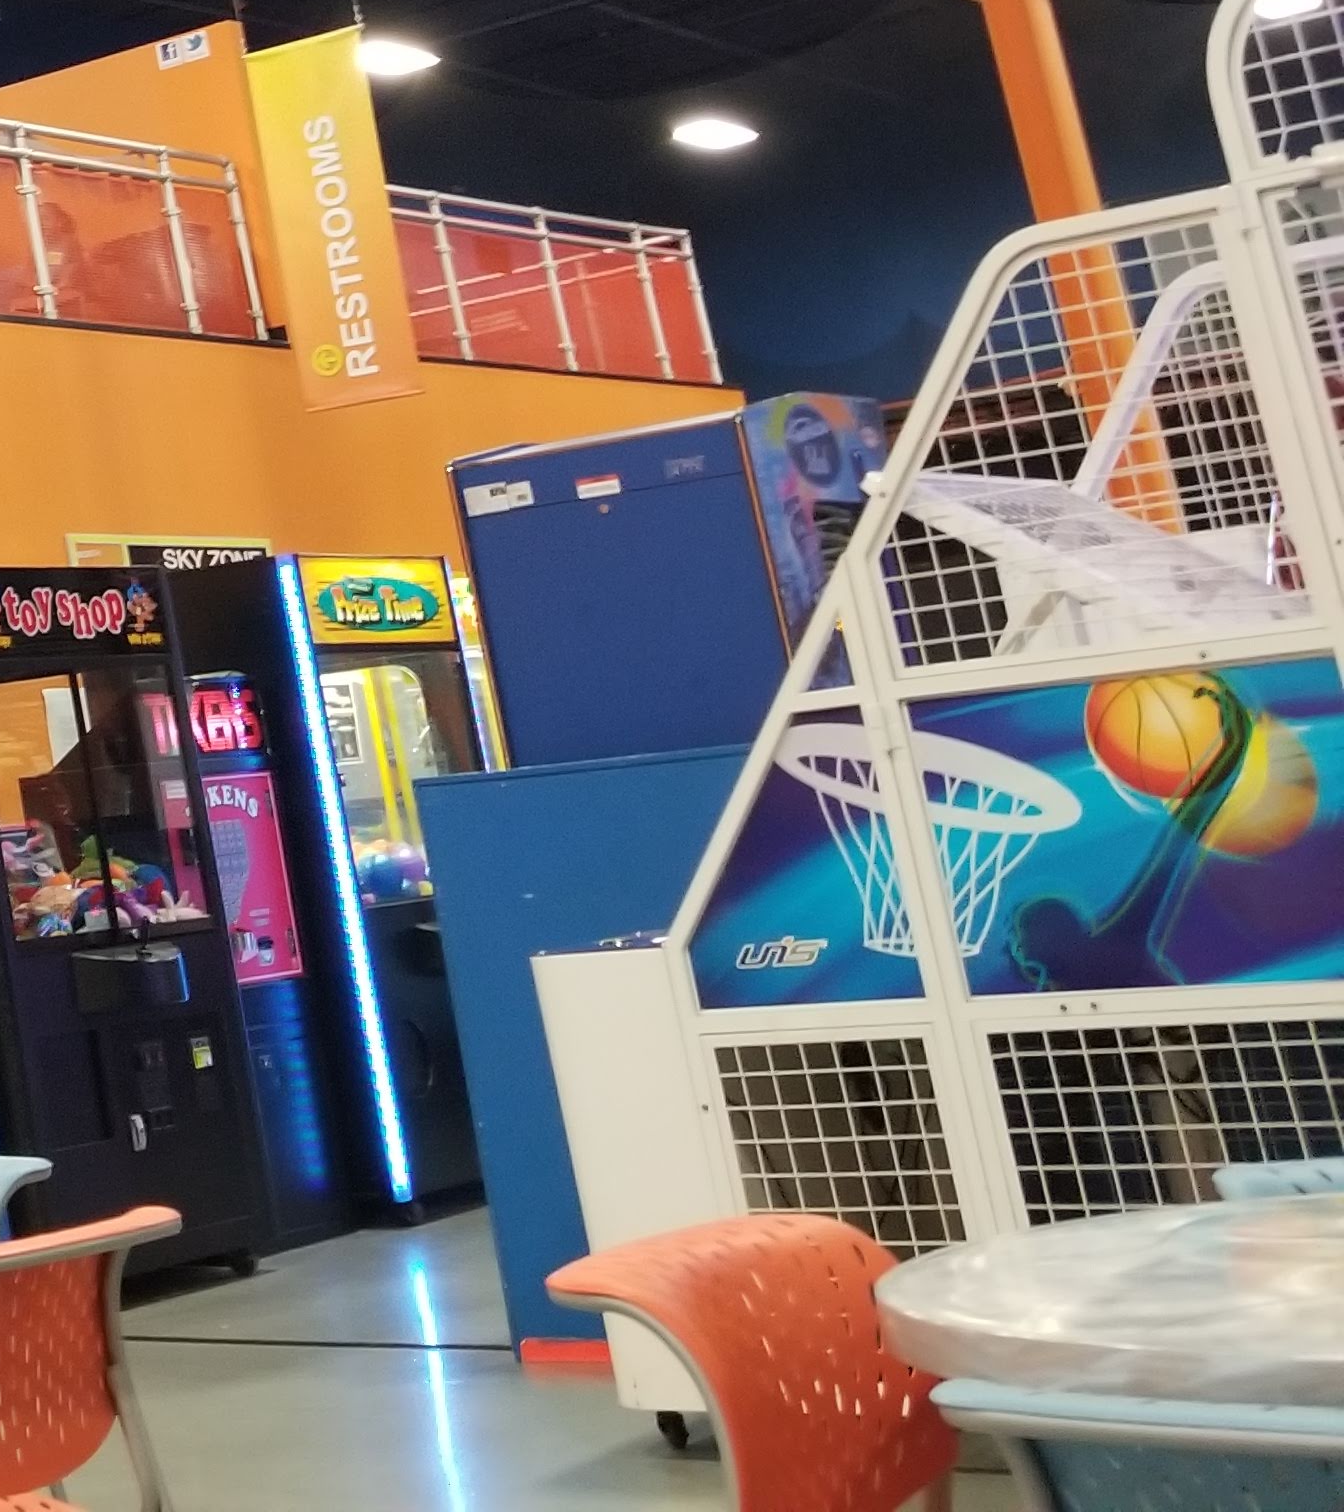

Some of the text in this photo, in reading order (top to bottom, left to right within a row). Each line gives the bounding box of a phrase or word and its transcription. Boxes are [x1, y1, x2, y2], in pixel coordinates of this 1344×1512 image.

[303, 114, 382, 379] RESTROOMS
[162, 548, 204, 570] SKY
[1, 586, 126, 639] toy shop
[205, 784, 259, 818] KENS
